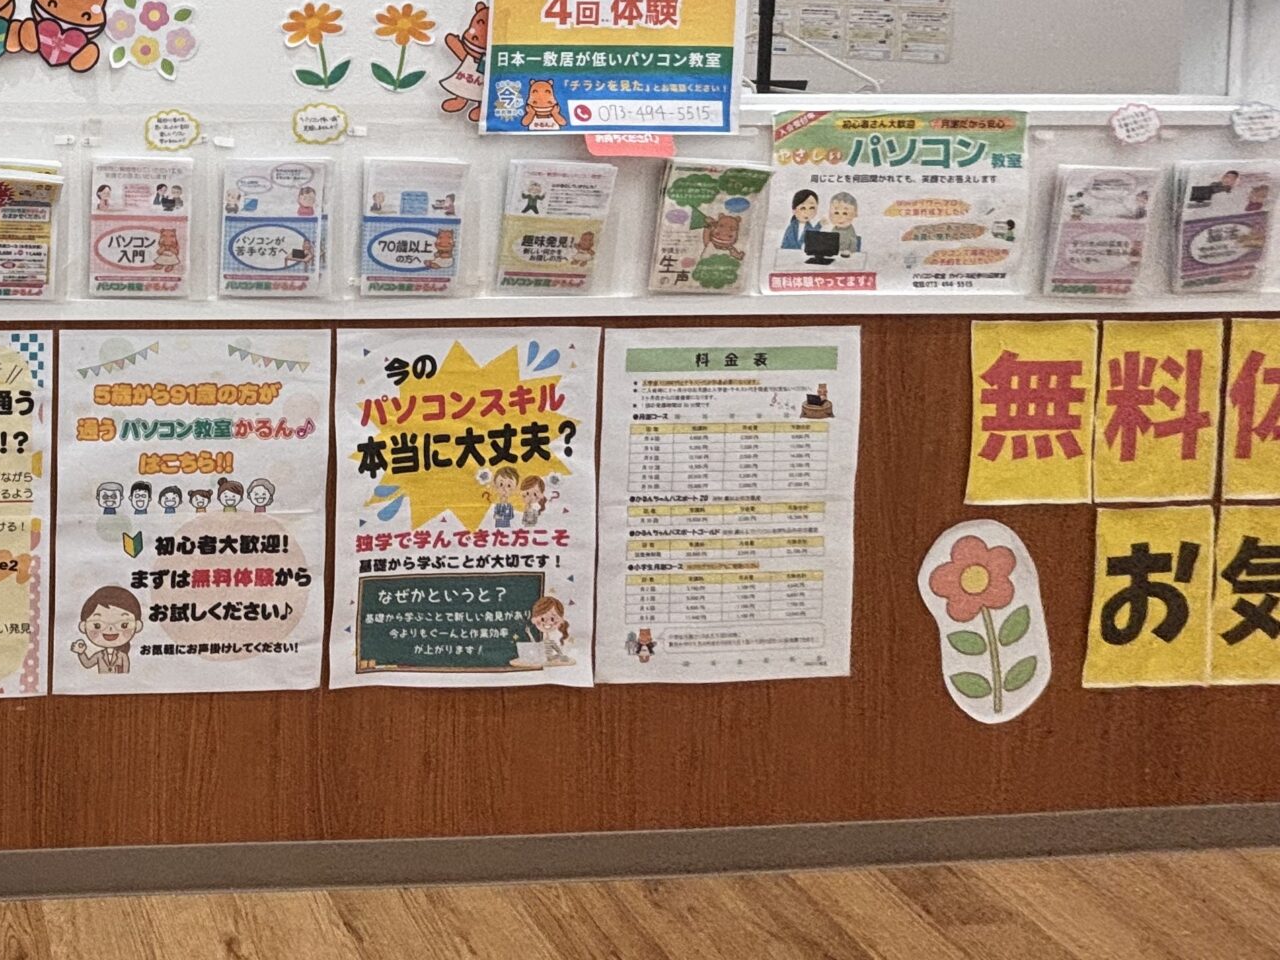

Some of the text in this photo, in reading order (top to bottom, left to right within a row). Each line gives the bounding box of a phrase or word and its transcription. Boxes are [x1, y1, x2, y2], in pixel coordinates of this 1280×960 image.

[496, 50, 721, 69] 日本一敷居が低いパソコン教室
[598, 104, 711, 122] 073-494-5515
[776, 132, 1024, 170] やさしい パソコン 教室
[107, 235, 157, 249] パソコン
[235, 235, 285, 246] パソコンが
[377, 239, 434, 255] 70歳以上
[520, 233, 575, 248] 趣味発見！
[117, 250, 146, 264] 入門
[235, 245, 288, 258] 苦手な方へ
[395, 254, 422, 264] の方へ
[384, 353, 439, 386] 今の
[92, 380, 283, 406] 5歳から91歳の方が
[360, 382, 567, 428] パソコンスキル
[356, 419, 578, 480] 本当に大丈夫？
[138, 450, 235, 476] はこちら!!
[154, 534, 290, 557] 初心者大歓迎!
[355, 528, 571, 554] 独学で学んできた方こそ
[358, 554, 562, 575] 基礎から学ぶことが大切です！
[130, 566, 313, 590] まずは無料体験から
[377, 586, 508, 606] なぜかというと？
[148, 600, 294, 624] お試しください♪
[364, 610, 533, 625] 基礎から学ぶことで新しい発見があり
[388, 626, 510, 640] 今よりもぐーんと作業効率
[139, 641, 300, 657] お気軽にお声掛けしてください!
[413, 643, 484, 656] が上がります！
